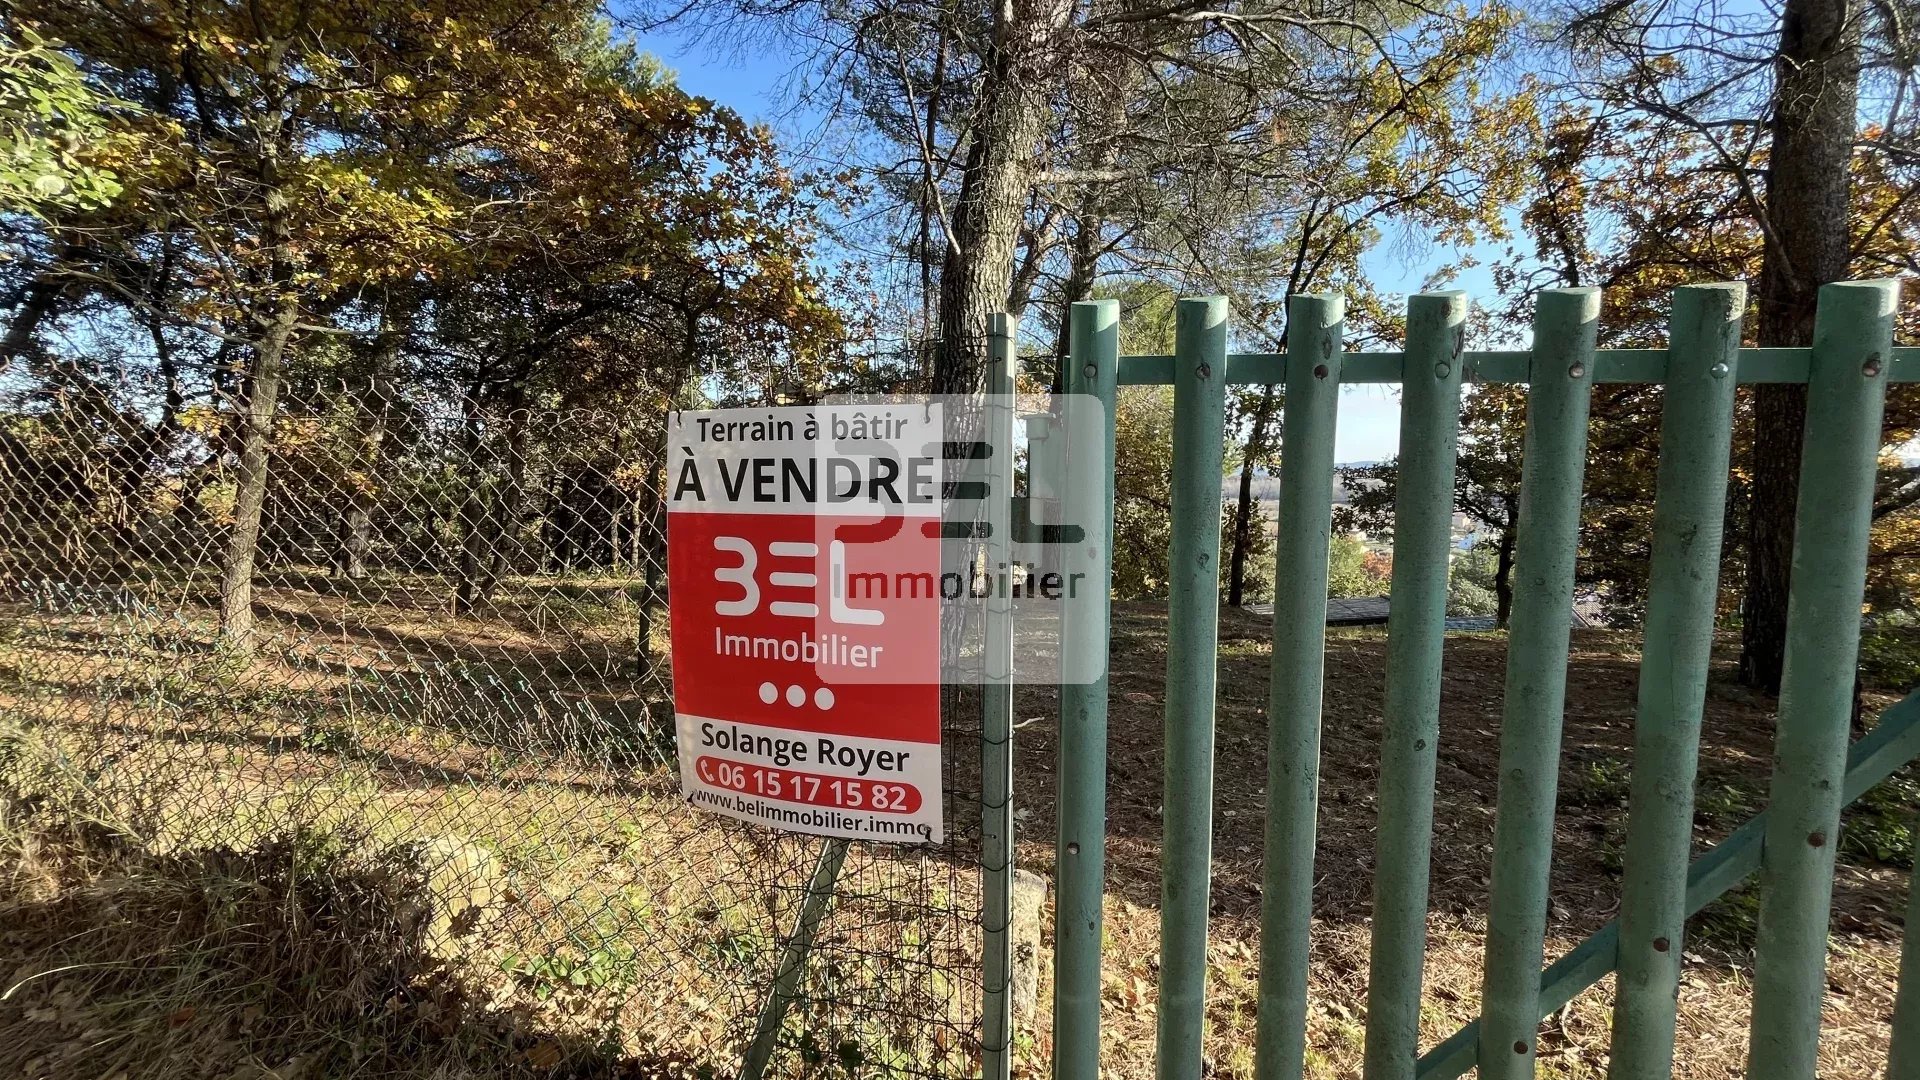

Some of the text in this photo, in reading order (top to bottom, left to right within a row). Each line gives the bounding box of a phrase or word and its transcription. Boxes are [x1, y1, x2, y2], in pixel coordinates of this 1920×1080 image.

[696, 411, 908, 442] Terrain à bâtir
[673, 446, 935, 504] À VENDRE
[714, 536, 885, 626] BEL
[715, 626, 884, 668] Immobilier
[701, 722, 910, 777] Solange Royer
[717, 762, 908, 811] 06 15 17 15 82
